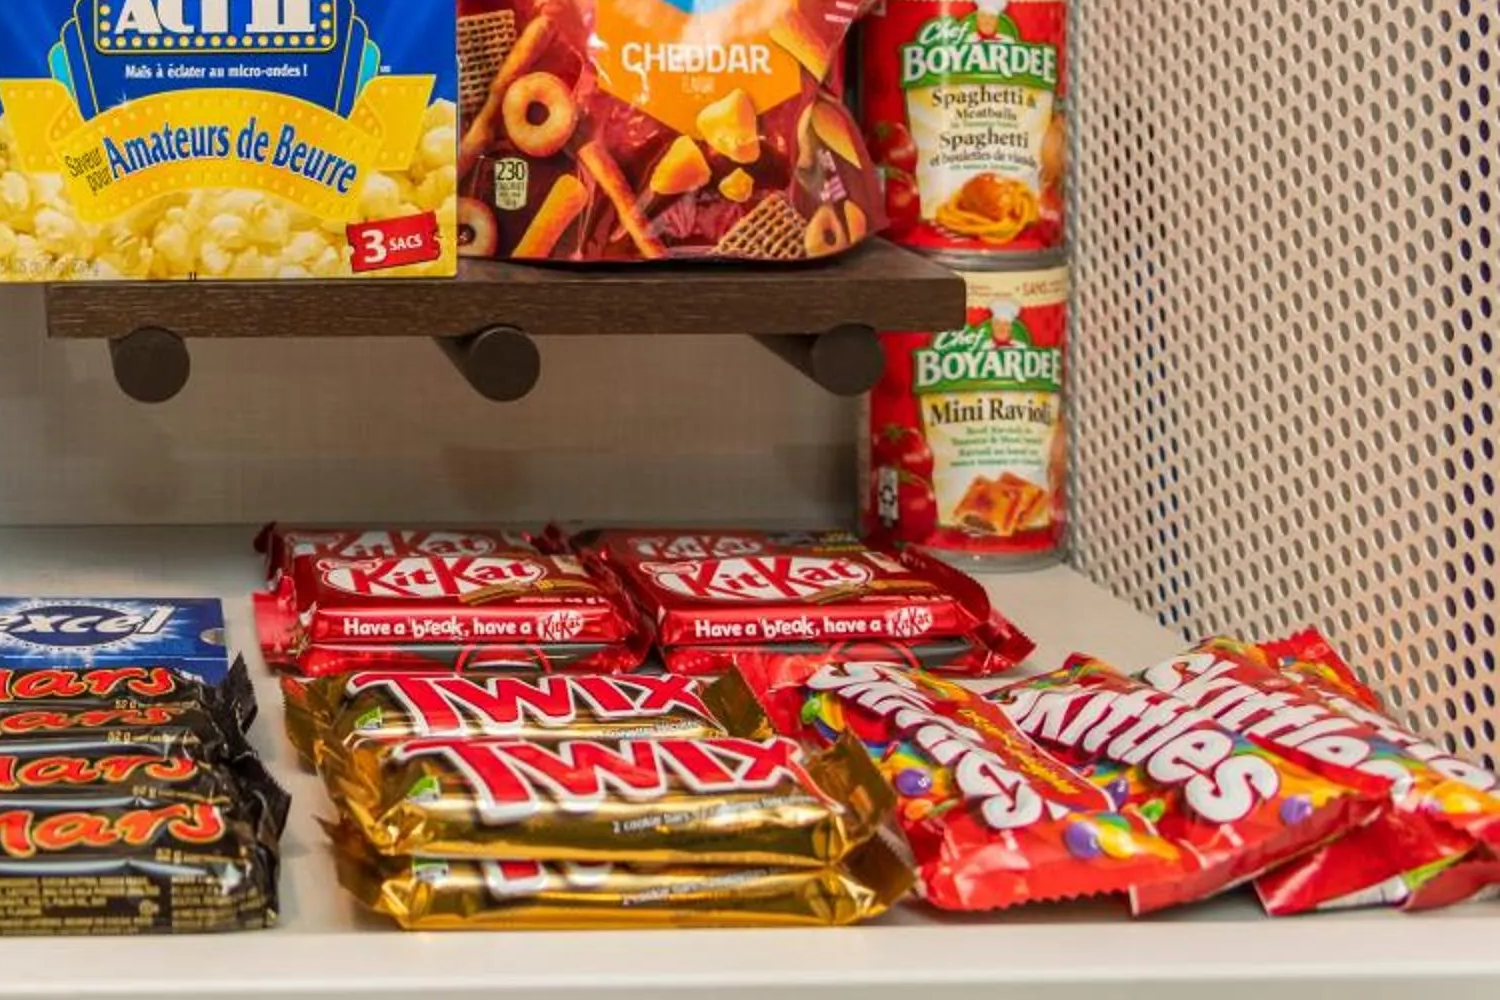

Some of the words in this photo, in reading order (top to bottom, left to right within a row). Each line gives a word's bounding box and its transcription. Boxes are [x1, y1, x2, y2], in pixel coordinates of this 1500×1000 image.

[920, 21, 972, 46] Chef
[125, 63, 153, 79] Maïs
[155, 64, 165, 79] à
[166, 62, 206, 79] éclater
[209, 66, 225, 79] au
[228, 62, 302, 79] micro-ondes
[621, 42, 773, 75] CHEDDAR
[903, 42, 1058, 83] BOYARDEE
[931, 84, 1023, 109] Spaghetti
[939, 126, 1029, 150] Spaghetti
[64, 148, 104, 179] Saveur
[101, 118, 231, 181] Amateurs
[236, 117, 266, 159] de
[274, 123, 358, 196] Beurre
[497, 160, 526, 182] 230
[86, 166, 113, 197] pour
[360, 228, 386, 265] 3
[387, 232, 424, 254] SACS
[933, 330, 983, 352] Chef
[917, 348, 1062, 388] BOYARDEE
[930, 398, 984, 427] Mini
[351, 556, 537, 597] KitKat
[677, 556, 860, 599] KitKat
[343, 616, 390, 637] Have
[393, 622, 405, 635] a
[473, 617, 517, 635] have
[520, 621, 532, 635] a
[695, 619, 742, 638] Have
[744, 623, 757, 637] a
[823, 617, 869, 635] have
[871, 621, 881, 633] a
[348, 671, 704, 738] TWIX
[394, 736, 805, 823] TWIX
